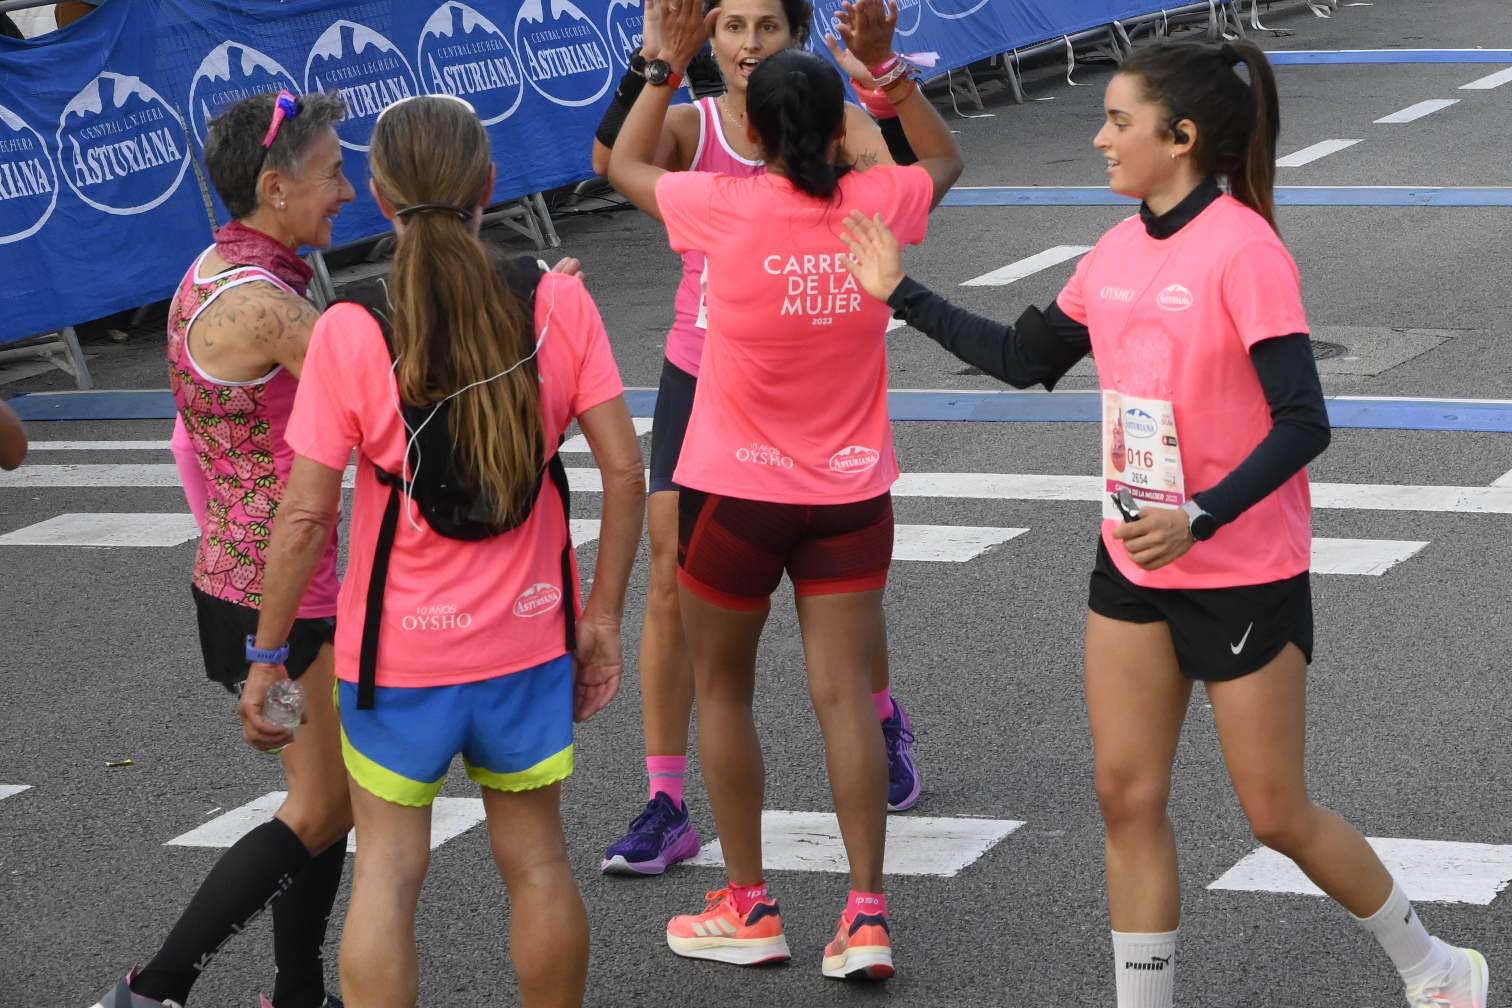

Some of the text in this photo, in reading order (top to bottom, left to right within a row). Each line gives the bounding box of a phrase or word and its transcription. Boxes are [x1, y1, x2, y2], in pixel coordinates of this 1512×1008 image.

[625, 14, 645, 28] CENT
[531, 24, 592, 44] CENTRAL LECHERA
[437, 38, 504, 60] CENTRAL LECHERA
[523, 36, 609, 82] ASTURIANA
[325, 57, 401, 83] CENTRAL LECHERA
[427, 52, 520, 97] ASTURIANA
[315, 75, 413, 122] TURIANA
[788, 273, 858, 296] DE LA
[780, 294, 862, 317] MUJER
[735, 447, 794, 470] OYSHO
[1127, 447, 1154, 469] 016
[401, 612, 472, 632] OYSHO
